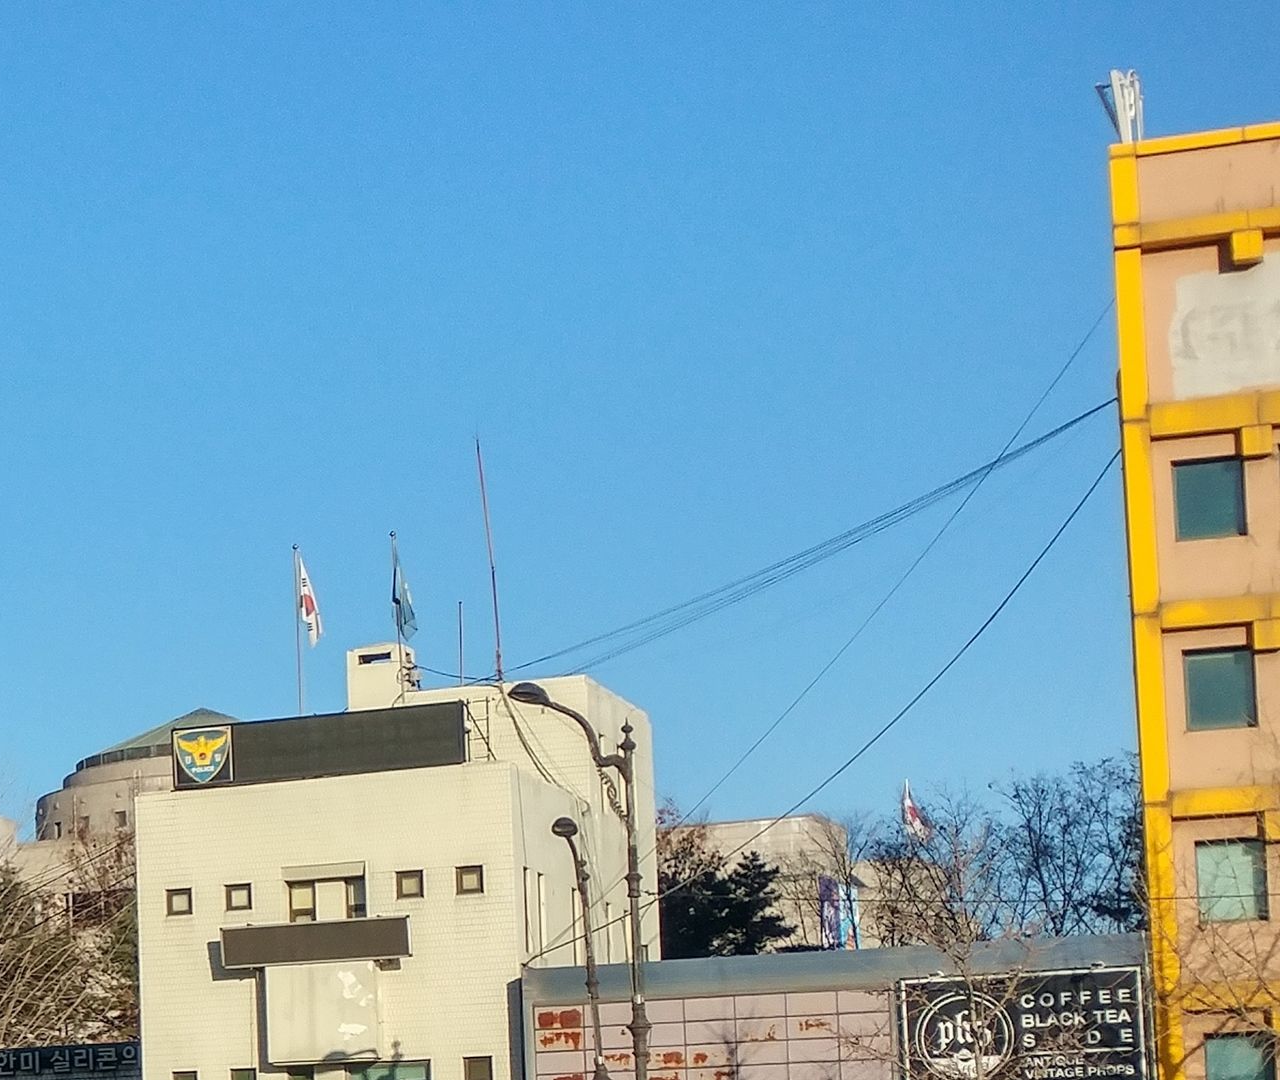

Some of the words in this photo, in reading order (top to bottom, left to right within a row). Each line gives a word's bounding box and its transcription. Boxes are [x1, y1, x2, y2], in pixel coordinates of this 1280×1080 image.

[1021, 988, 1132, 1008] COFFEE
[1021, 1012, 1088, 1029] BLACK
[1093, 1009, 1132, 1025] TEA
[1023, 1028, 1134, 1049] SDE
[48, 1045, 118, 1074] 실리콘
